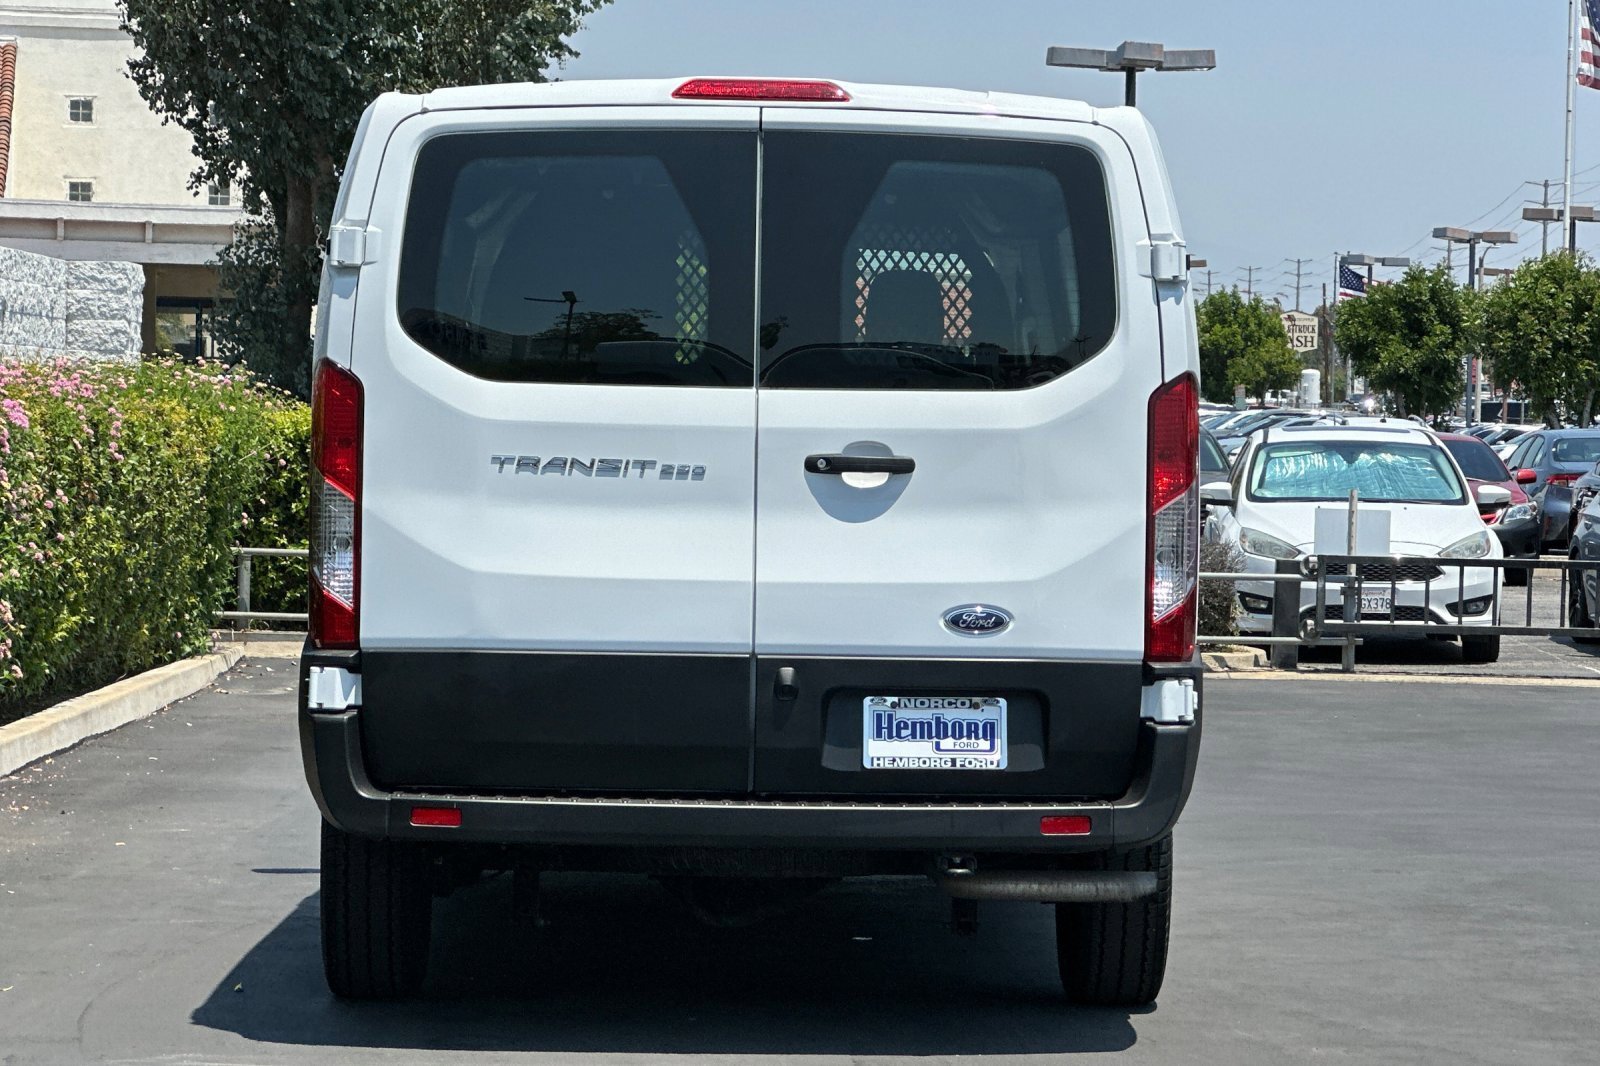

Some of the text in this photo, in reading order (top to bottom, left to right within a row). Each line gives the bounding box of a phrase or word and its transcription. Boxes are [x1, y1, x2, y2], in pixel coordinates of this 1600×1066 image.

[1294, 324, 1316, 334] TRUCK
[490, 454, 657, 479] TRANSIT
[1360, 597, 1391, 610] GX378
[958, 612, 996, 628] Ford
[899, 697, 971, 709] NORCO
[873, 710, 999, 752] Hemborg
[952, 741, 980, 749] FORD
[872, 757, 999, 768] HEMBORG FORD
